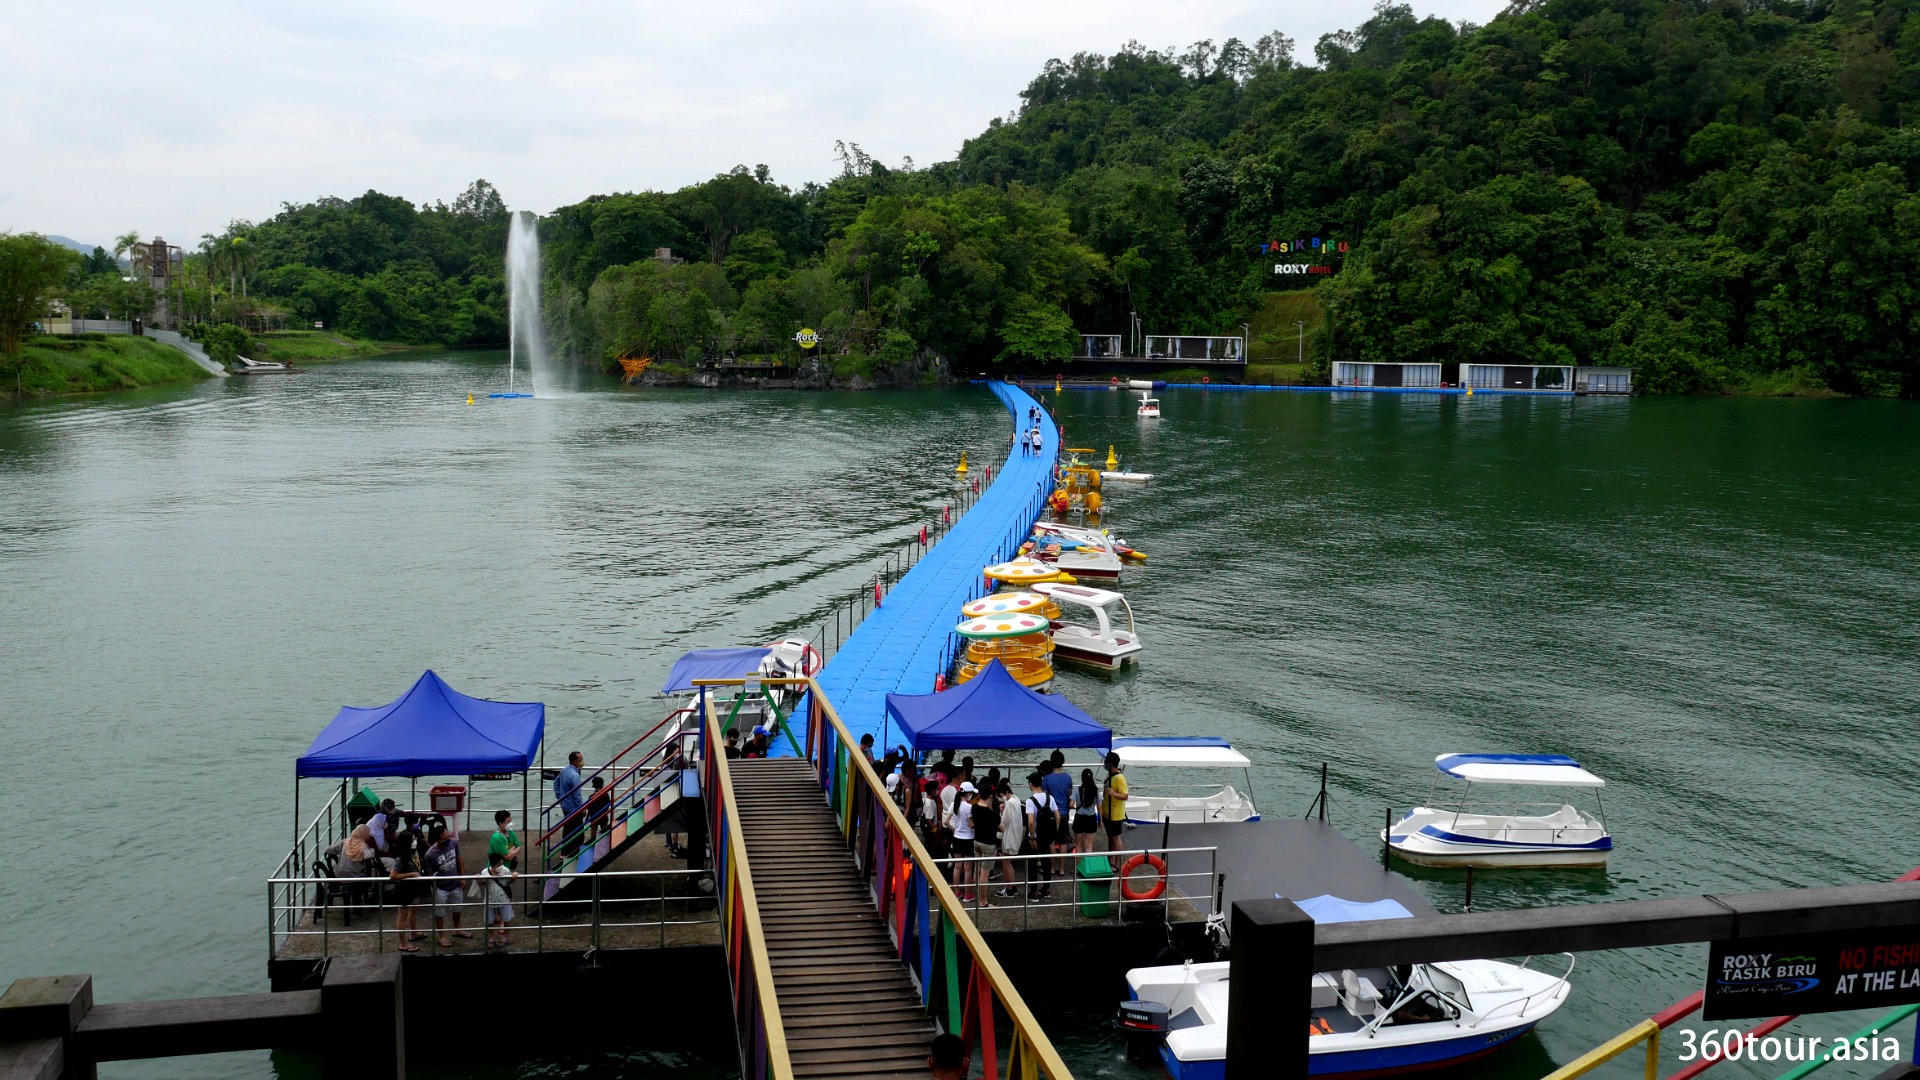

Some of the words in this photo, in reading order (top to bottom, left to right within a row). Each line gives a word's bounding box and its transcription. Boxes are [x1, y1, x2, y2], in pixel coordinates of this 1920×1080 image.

[1260, 239, 1305, 254] TASIK
[1311, 237, 1349, 254] BIRU
[1274, 263, 1309, 274] ROXY
[795, 331, 819, 342] Rock
[1723, 953, 1772, 969] ROXY
[1838, 947, 1867, 971] NO
[1722, 966, 1772, 981] TASIK
[1776, 963, 1817, 978] BIRU
[1834, 973, 1858, 995] AT
[1862, 970, 1897, 992] THE
